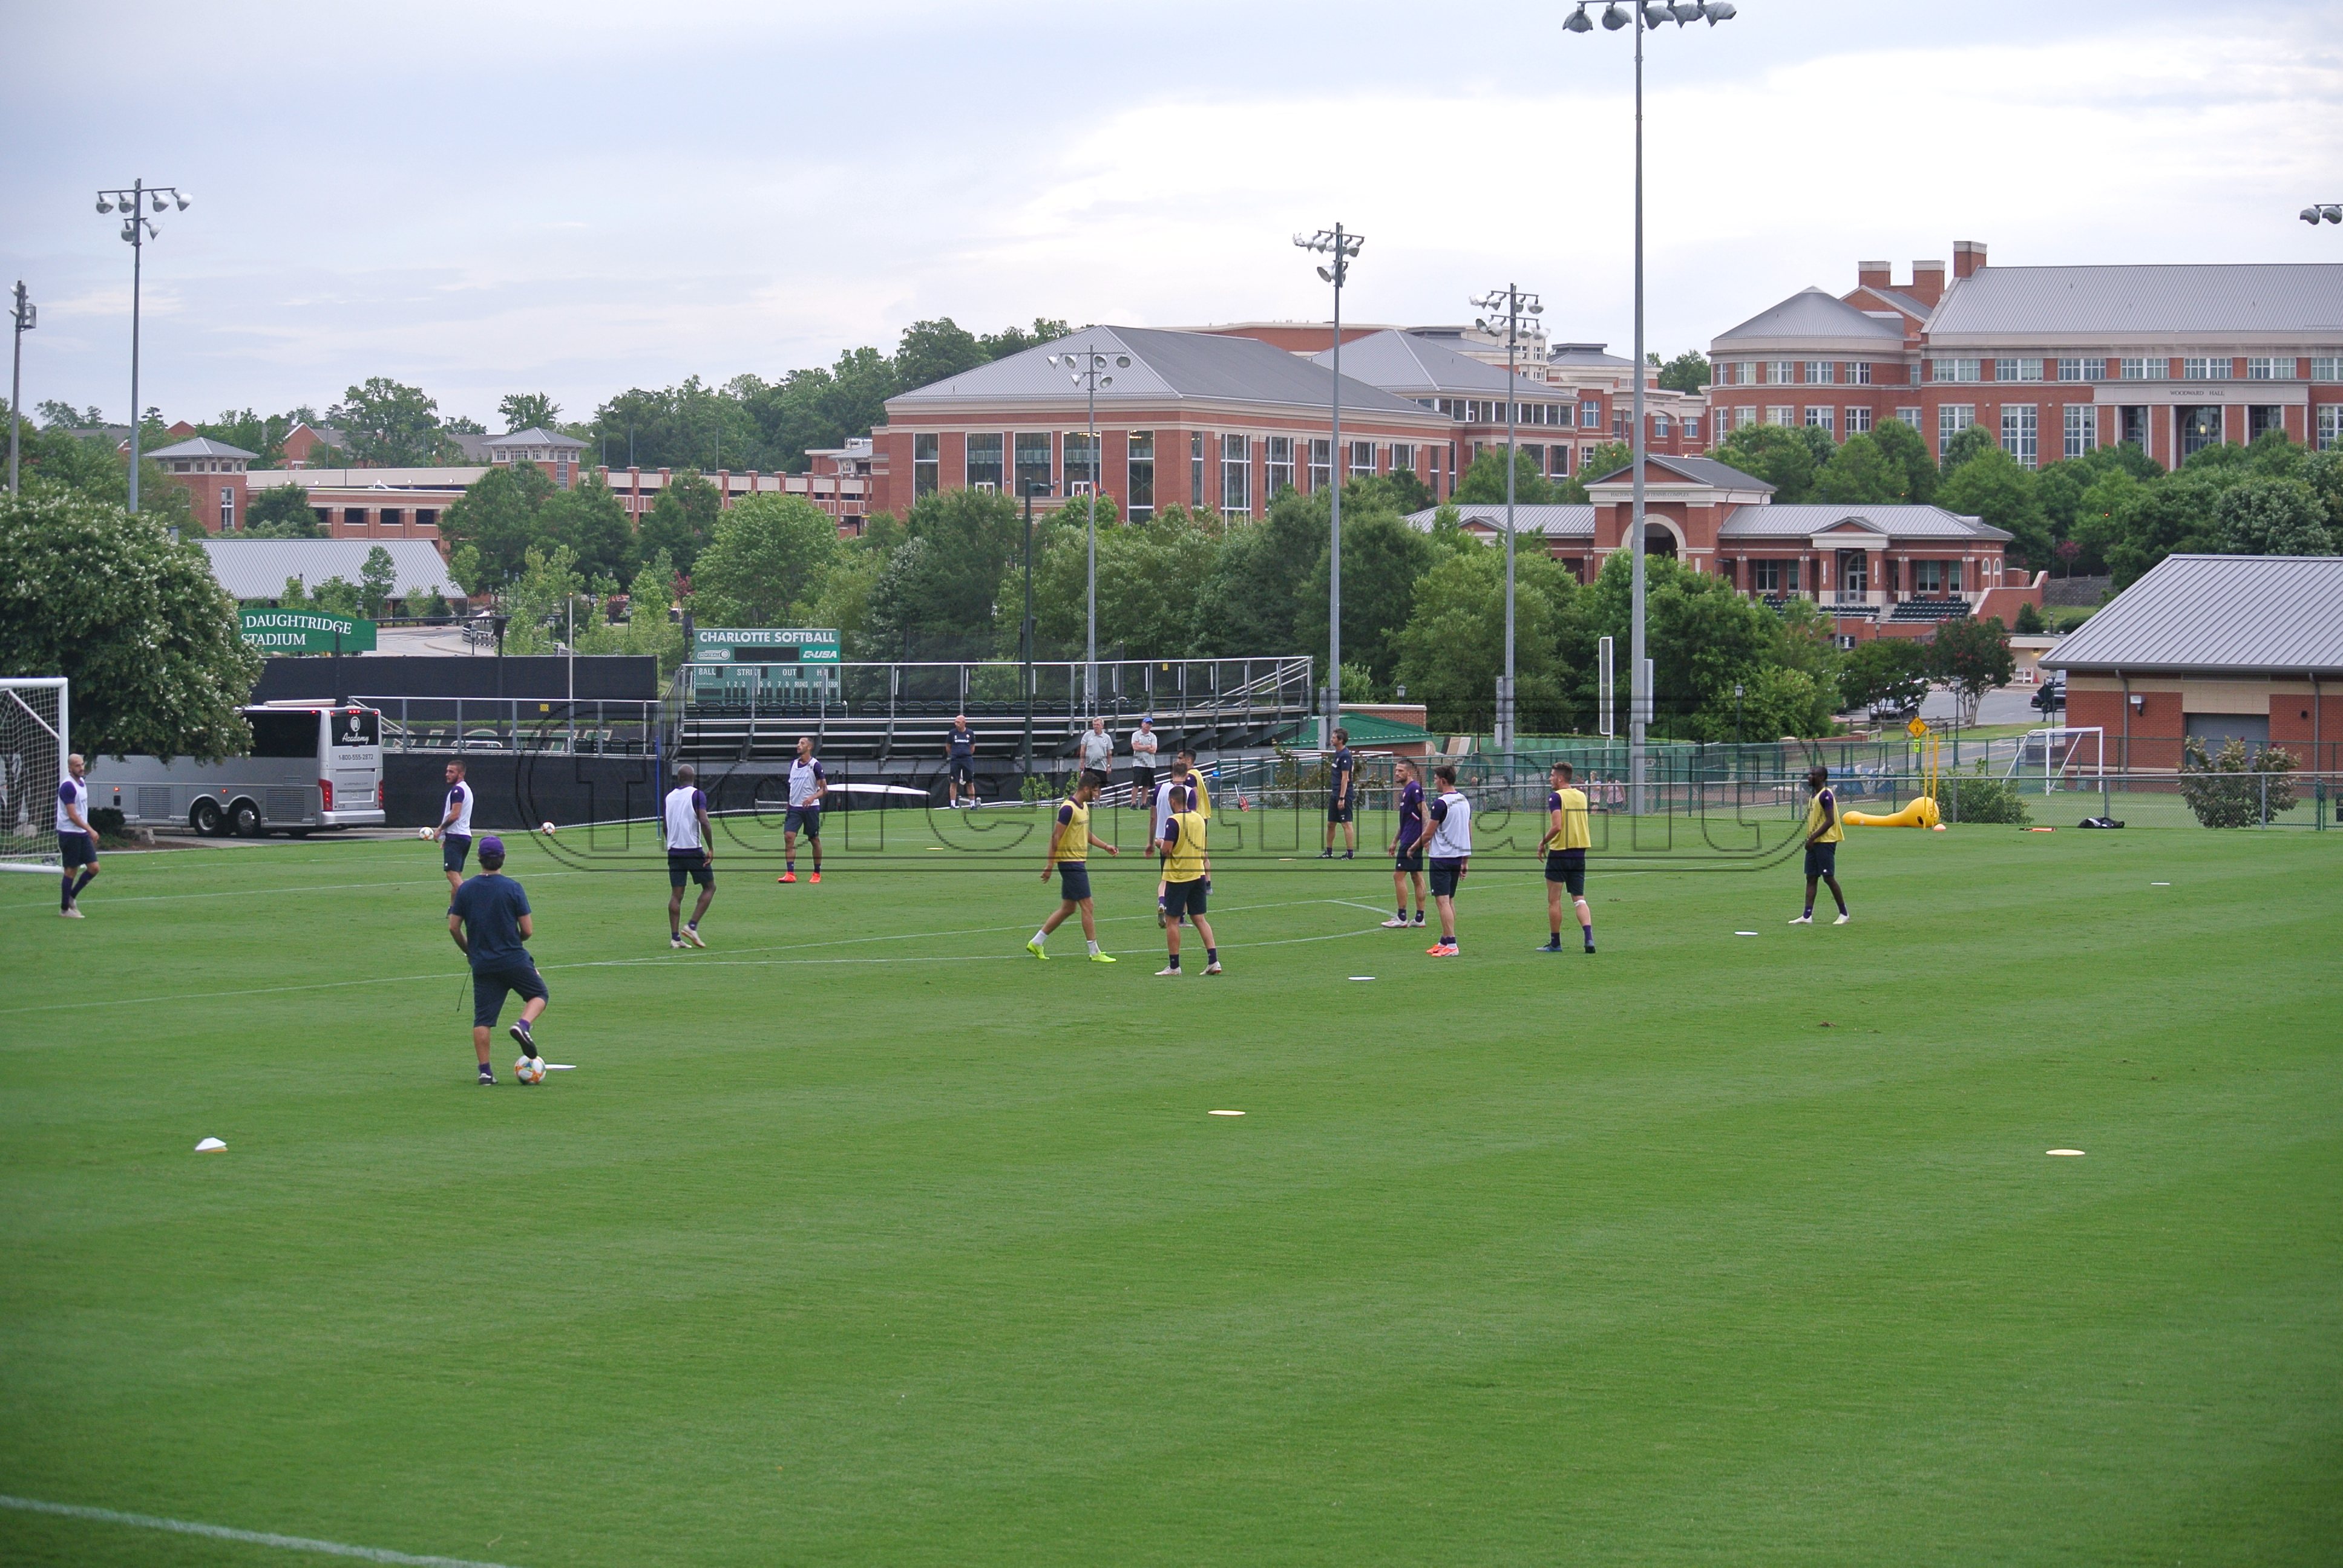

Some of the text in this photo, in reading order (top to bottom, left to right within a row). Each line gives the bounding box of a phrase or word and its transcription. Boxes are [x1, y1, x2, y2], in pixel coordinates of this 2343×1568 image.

[246, 615, 352, 634] DAUGHTRIDGE
[241, 633, 306, 645] STADIUM
[700, 632, 835, 642] CHARLOTTE SOFTBALL
[342, 733, 369, 744] Academy
